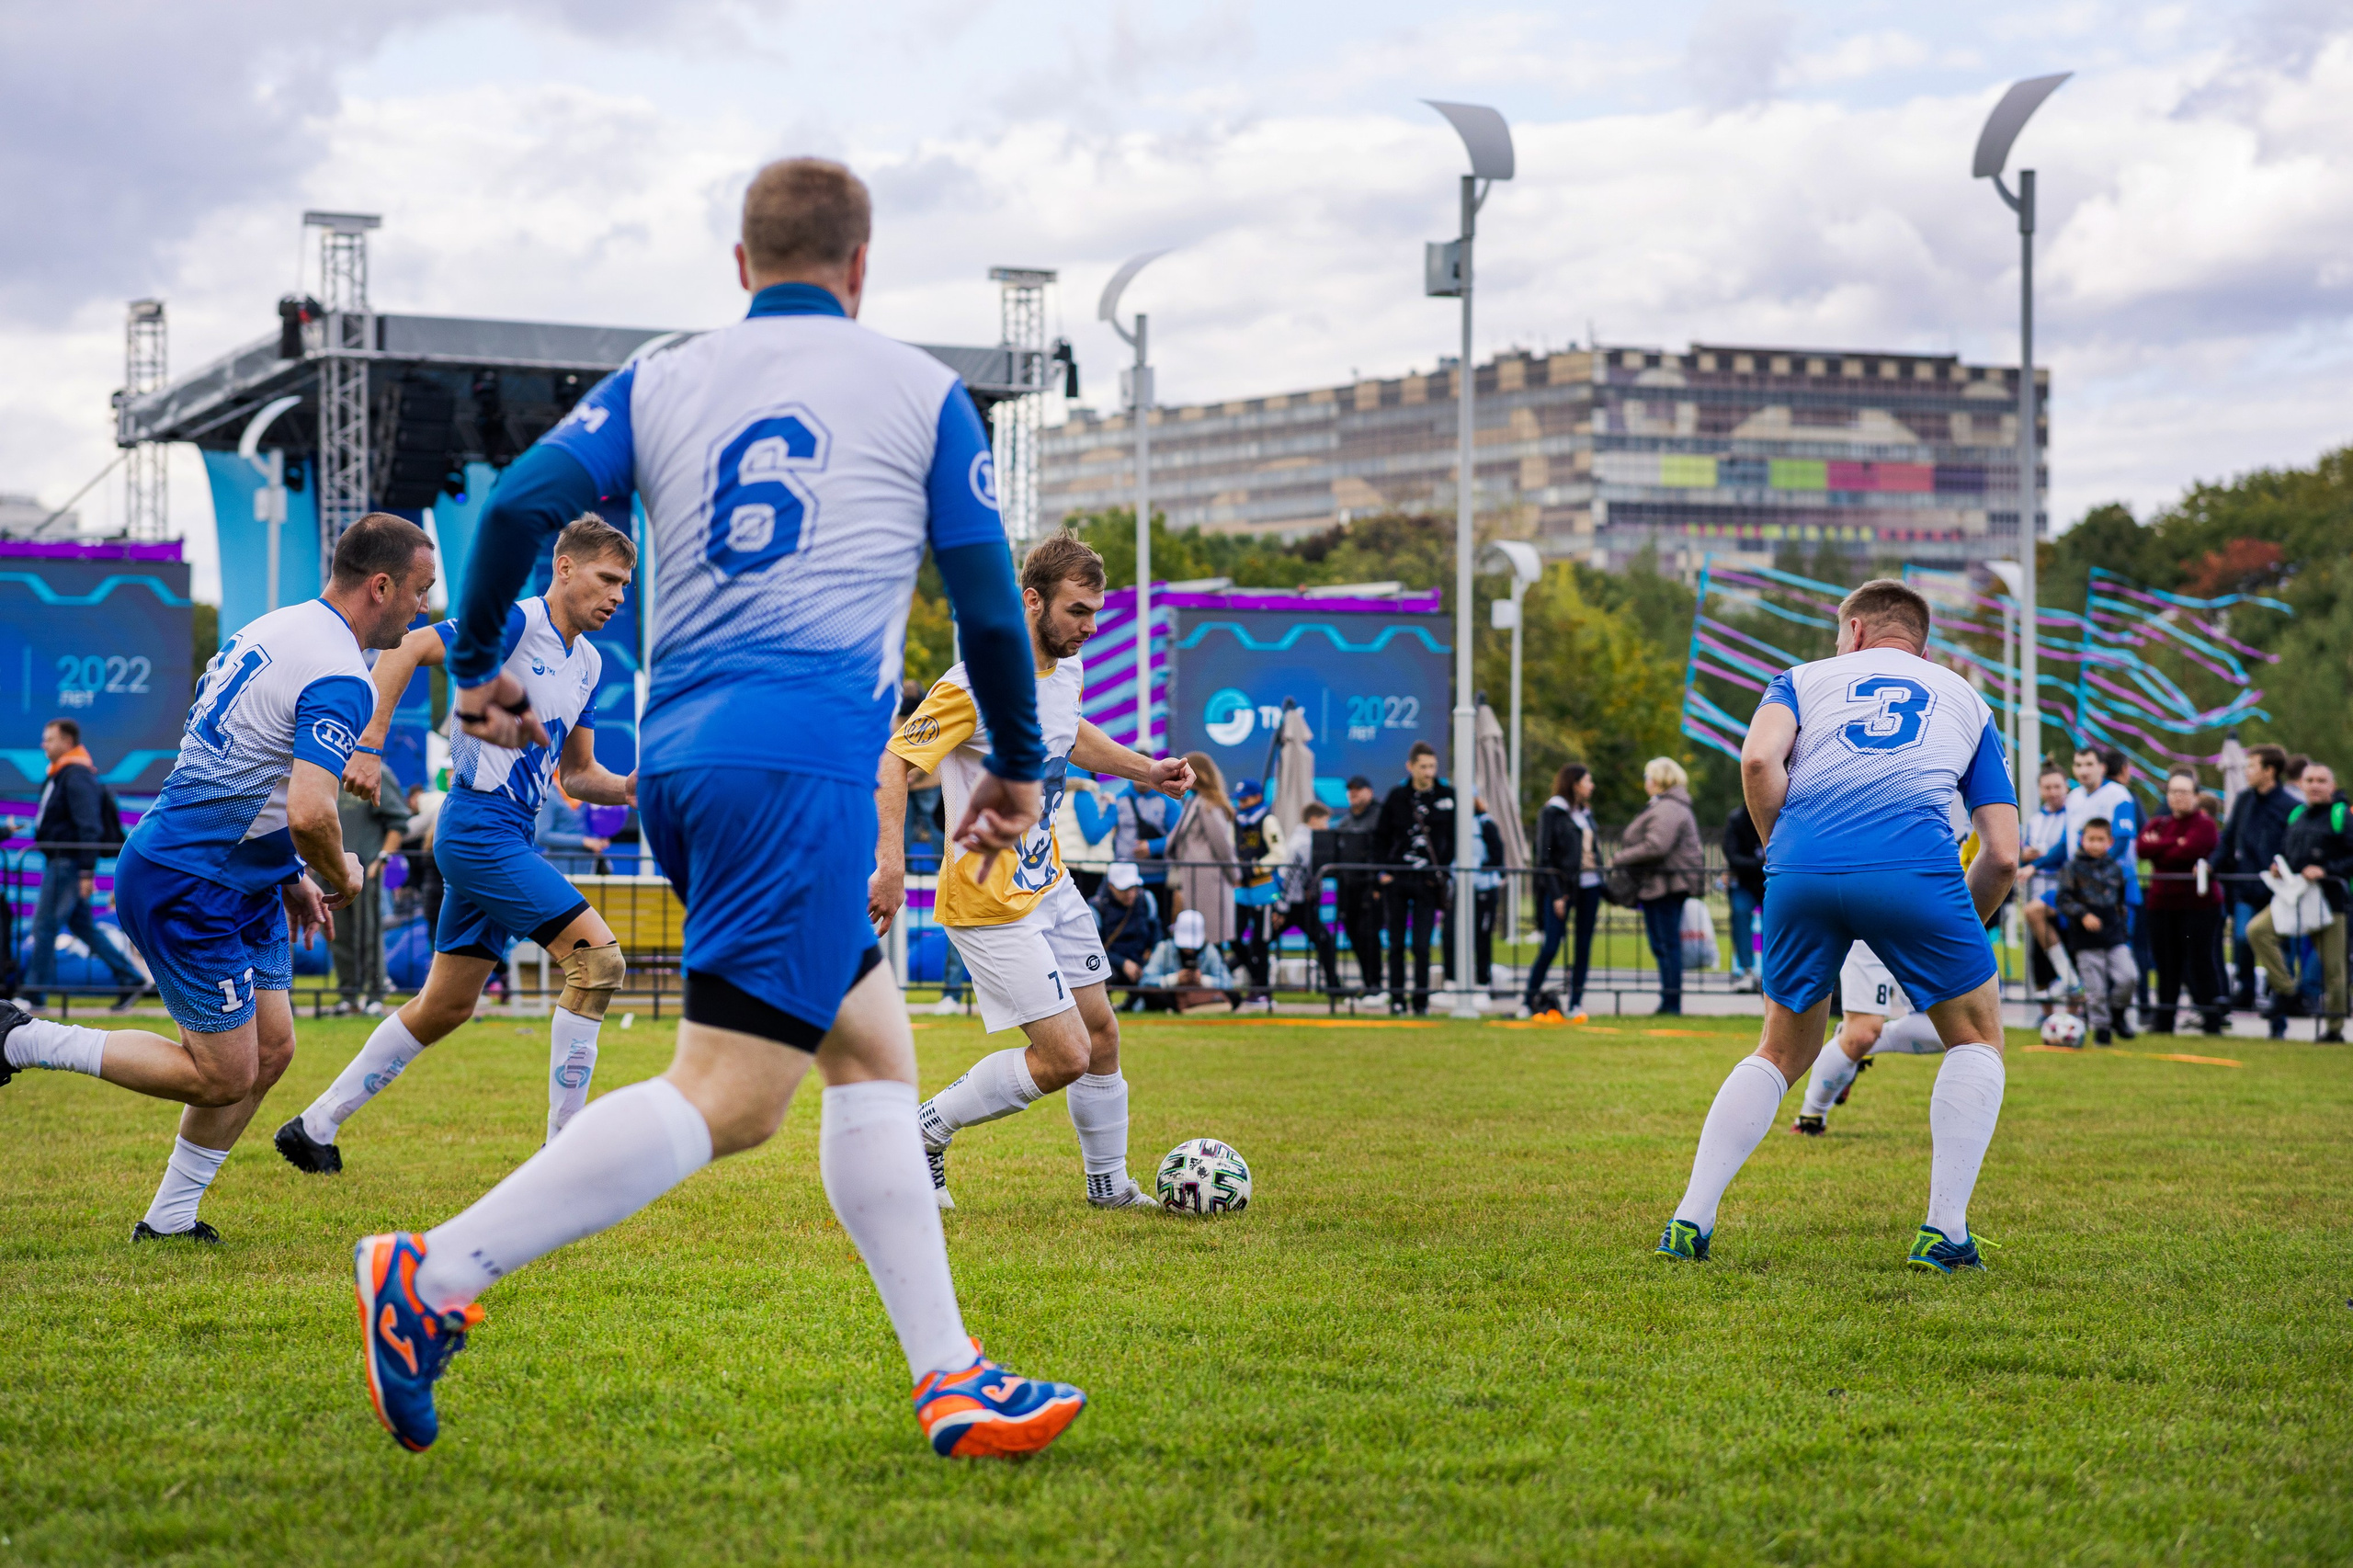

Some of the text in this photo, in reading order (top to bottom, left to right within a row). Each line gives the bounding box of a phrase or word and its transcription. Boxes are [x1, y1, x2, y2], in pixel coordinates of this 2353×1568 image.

[694, 402, 833, 585] 6
[55, 654, 152, 694] 2022
[1346, 695, 1420, 729] 2022
[1836, 673, 1938, 756] 3
[1047, 970, 1064, 1001] 7
[1876, 983, 1887, 1006] 8
